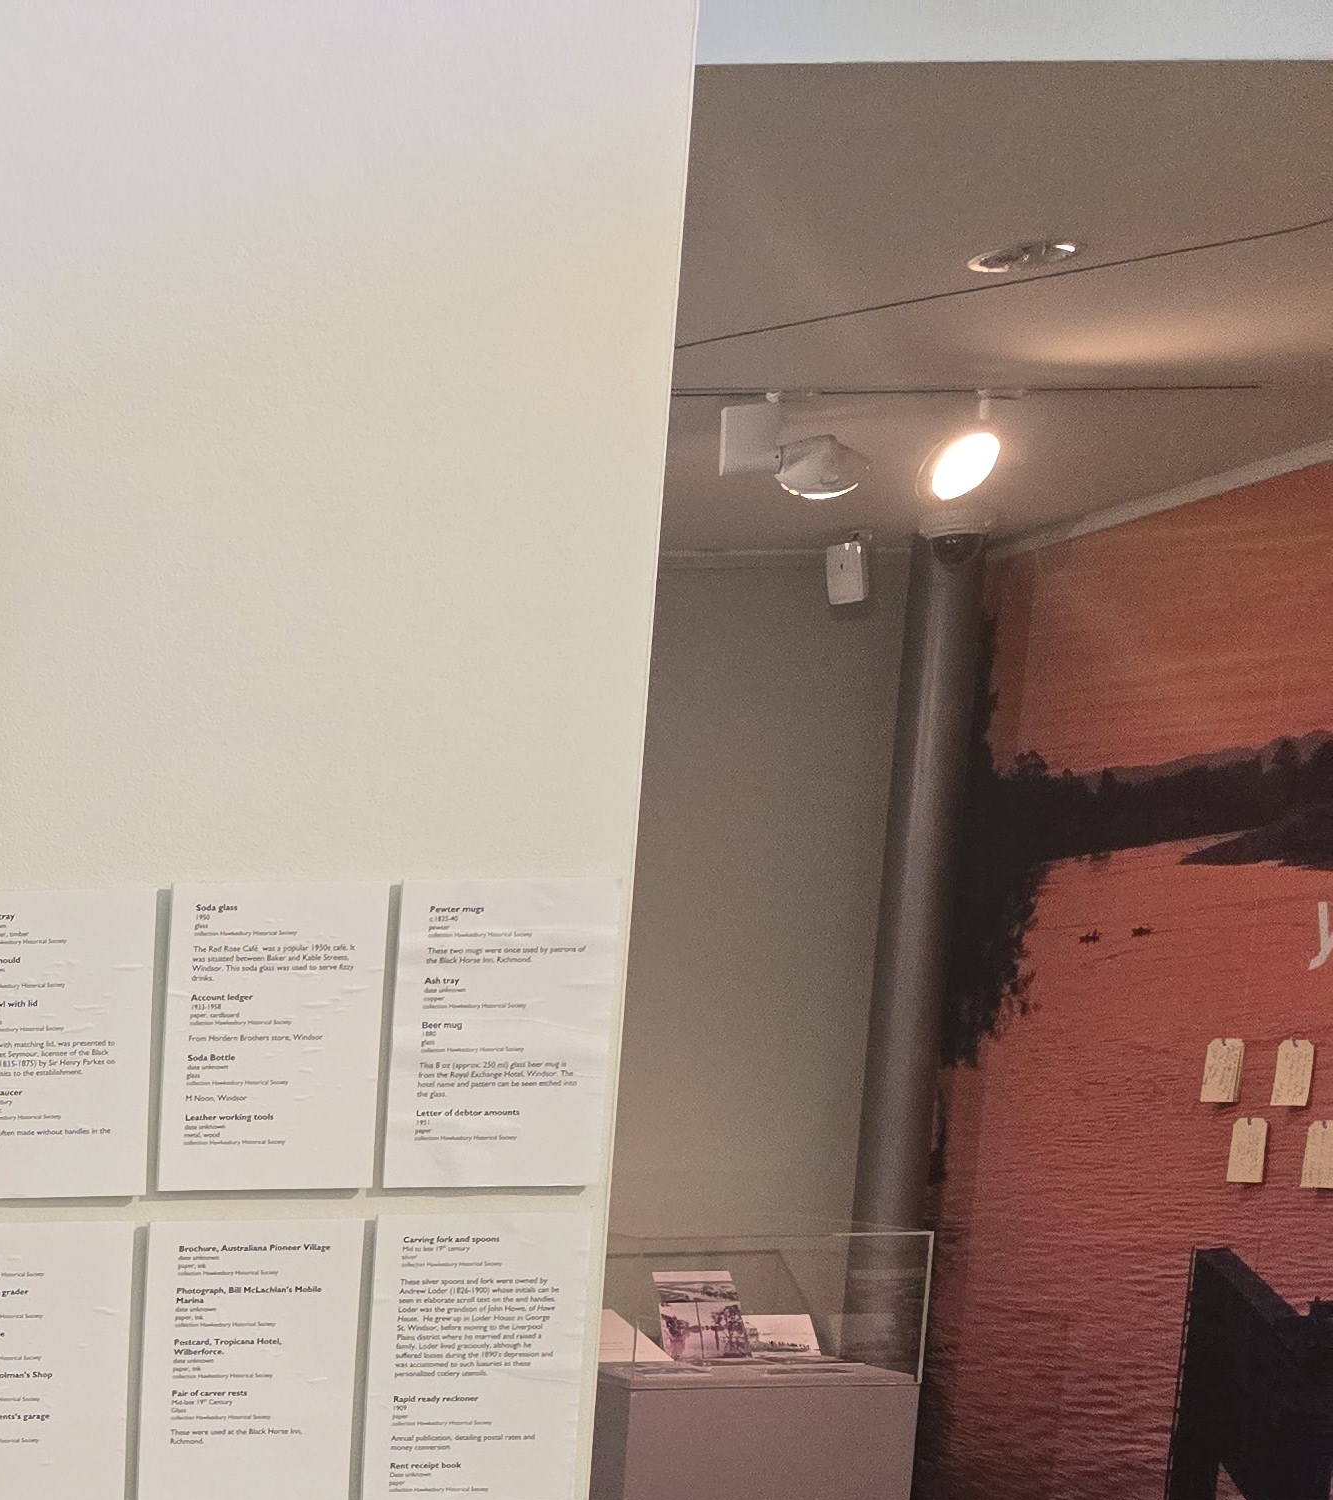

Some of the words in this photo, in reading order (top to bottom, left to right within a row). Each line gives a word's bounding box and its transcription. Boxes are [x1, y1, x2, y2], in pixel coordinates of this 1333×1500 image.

[218, 904, 237, 913] glass
[429, 905, 460, 913] Pewter
[462, 907, 484, 915] mugs
[442, 977, 459, 986] tray
[227, 993, 253, 1003] ledger
[27, 999, 37, 1007] lid
[421, 1021, 441, 1029] Beer
[443, 1023, 462, 1031] mug
[187, 1054, 207, 1062] Soda
[416, 1109, 442, 1117] Letter
[444, 1109, 452, 1117] of
[484, 1108, 520, 1116] amounts
[185, 1113, 216, 1121] Leather
[218, 1113, 251, 1123] working
[253, 1113, 273, 1121] tools
[403, 1235, 434, 1245] Carving
[436, 1235, 453, 1243] fork
[455, 1235, 470, 1243] and
[471, 1236, 500, 1245] spoons
[221, 1244, 267, 1252] Australiana
[303, 1243, 330, 1253] Village
[1, 1288, 28, 1298] grader
[228, 1286, 241, 1294] Bill
[294, 1285, 322, 1293] Mobile
[176, 1296, 204, 1304] Marina
[214, 1338, 254, 1347] Tropicana
[32, 1371, 52, 1380] Shop
[171, 1389, 188, 1397] Pair
[190, 1389, 199, 1397] of
[393, 1395, 416, 1405] Rapid
[417, 1395, 440, 1405] ready
[442, 1394, 478, 1402] reckoner
[23, 1414, 50, 1422] garage
[410, 1461, 439, 1471] receipt
[441, 1461, 461, 1469] book
